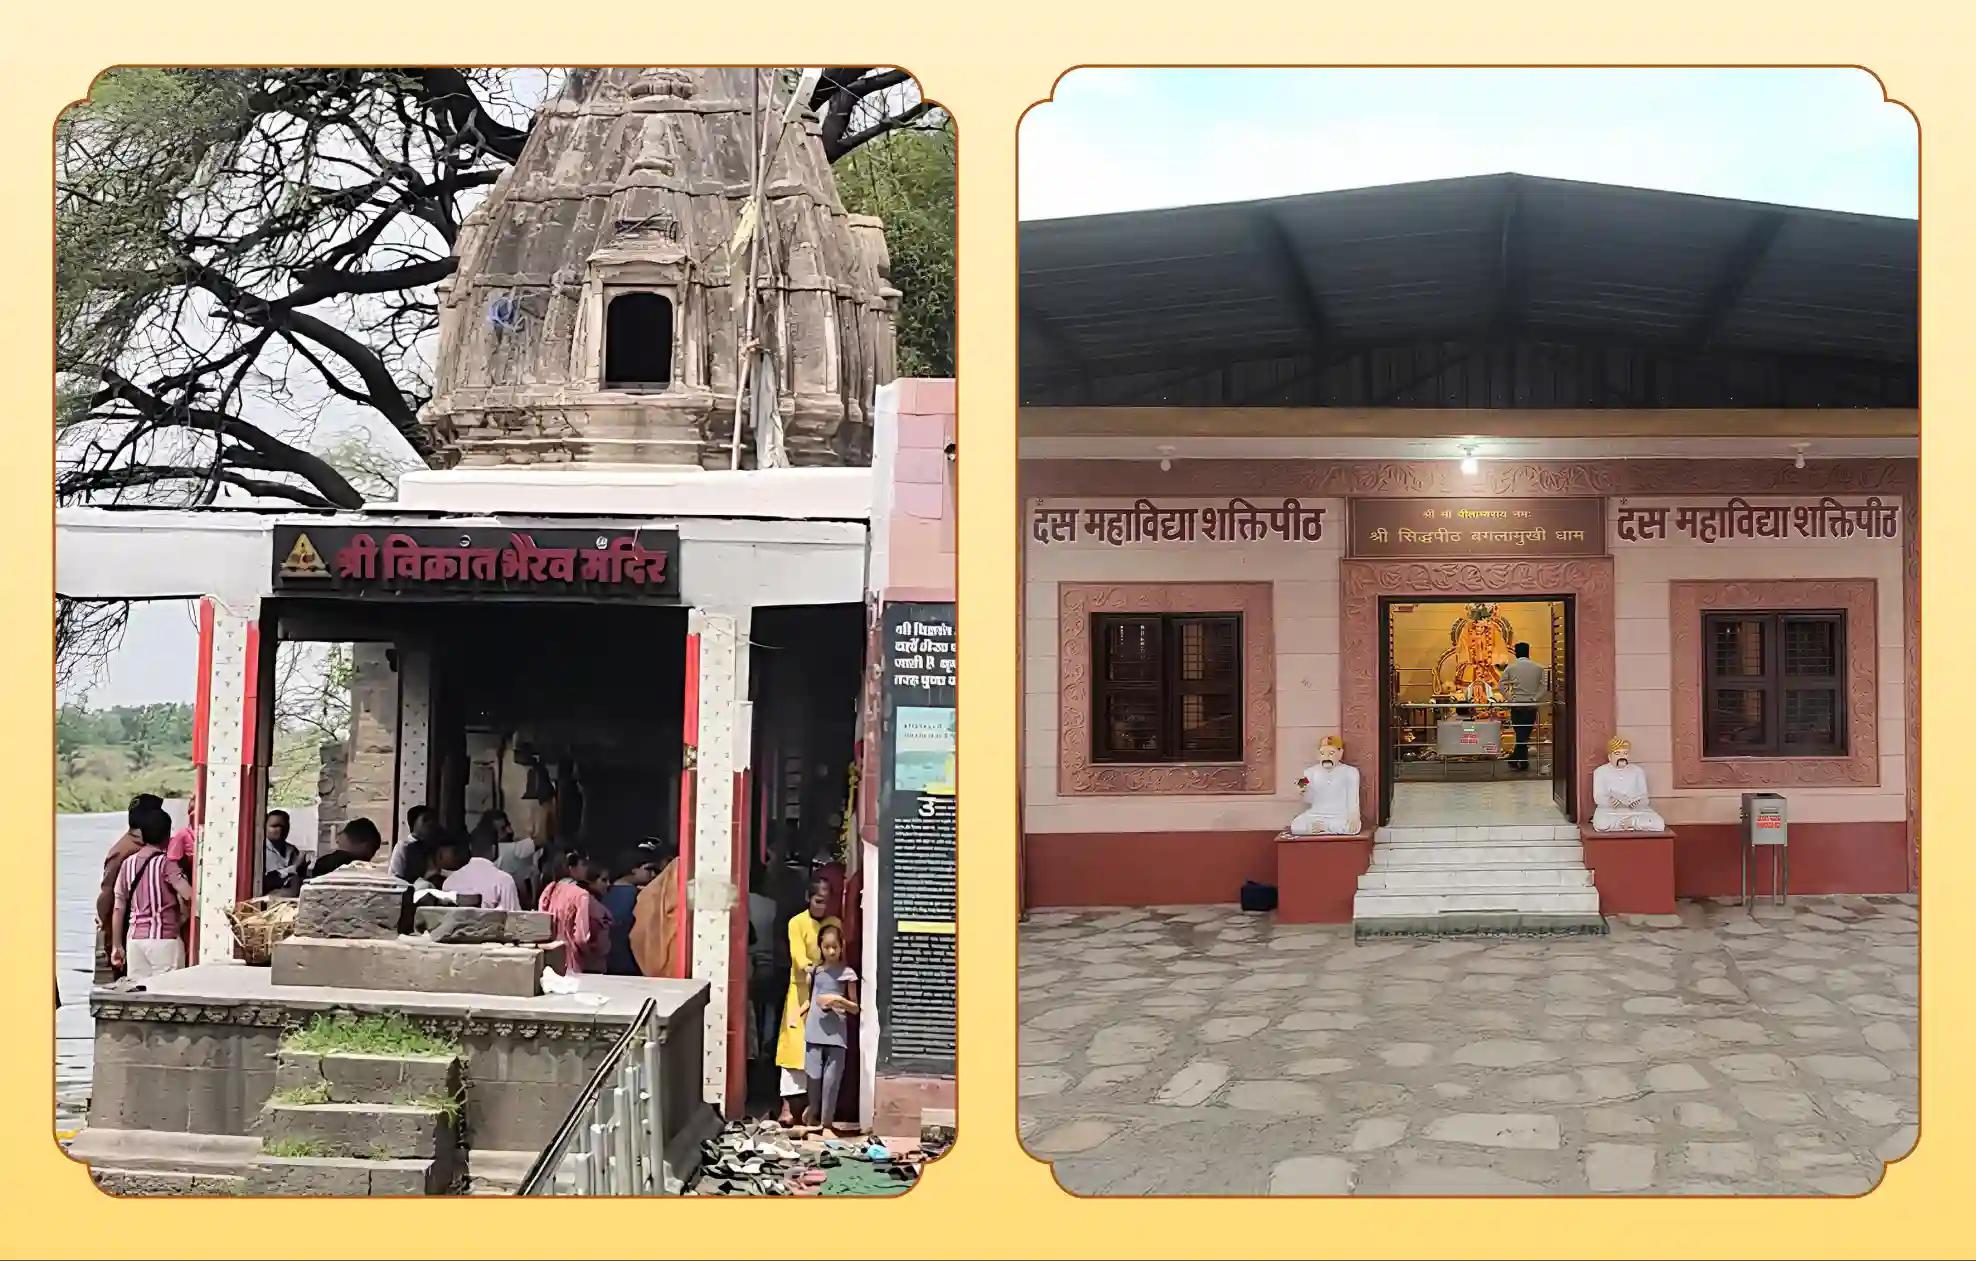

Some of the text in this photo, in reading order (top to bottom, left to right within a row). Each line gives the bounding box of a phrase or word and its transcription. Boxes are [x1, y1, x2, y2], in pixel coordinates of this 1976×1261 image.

[1084, 498, 1199, 546] महाविद्या
[1201, 497, 1327, 542] शक्तिपीठ
[1369, 526, 1585, 546] श्री सिद्धपीठ बगलामुखी धाम
[1675, 497, 1792, 544] महाविद्या
[1793, 496, 1900, 539] शक्तिपीठ
[335, 533, 377, 580] श्री
[500, 532, 575, 583] भैरव
[577, 534, 668, 584] मंदिर
